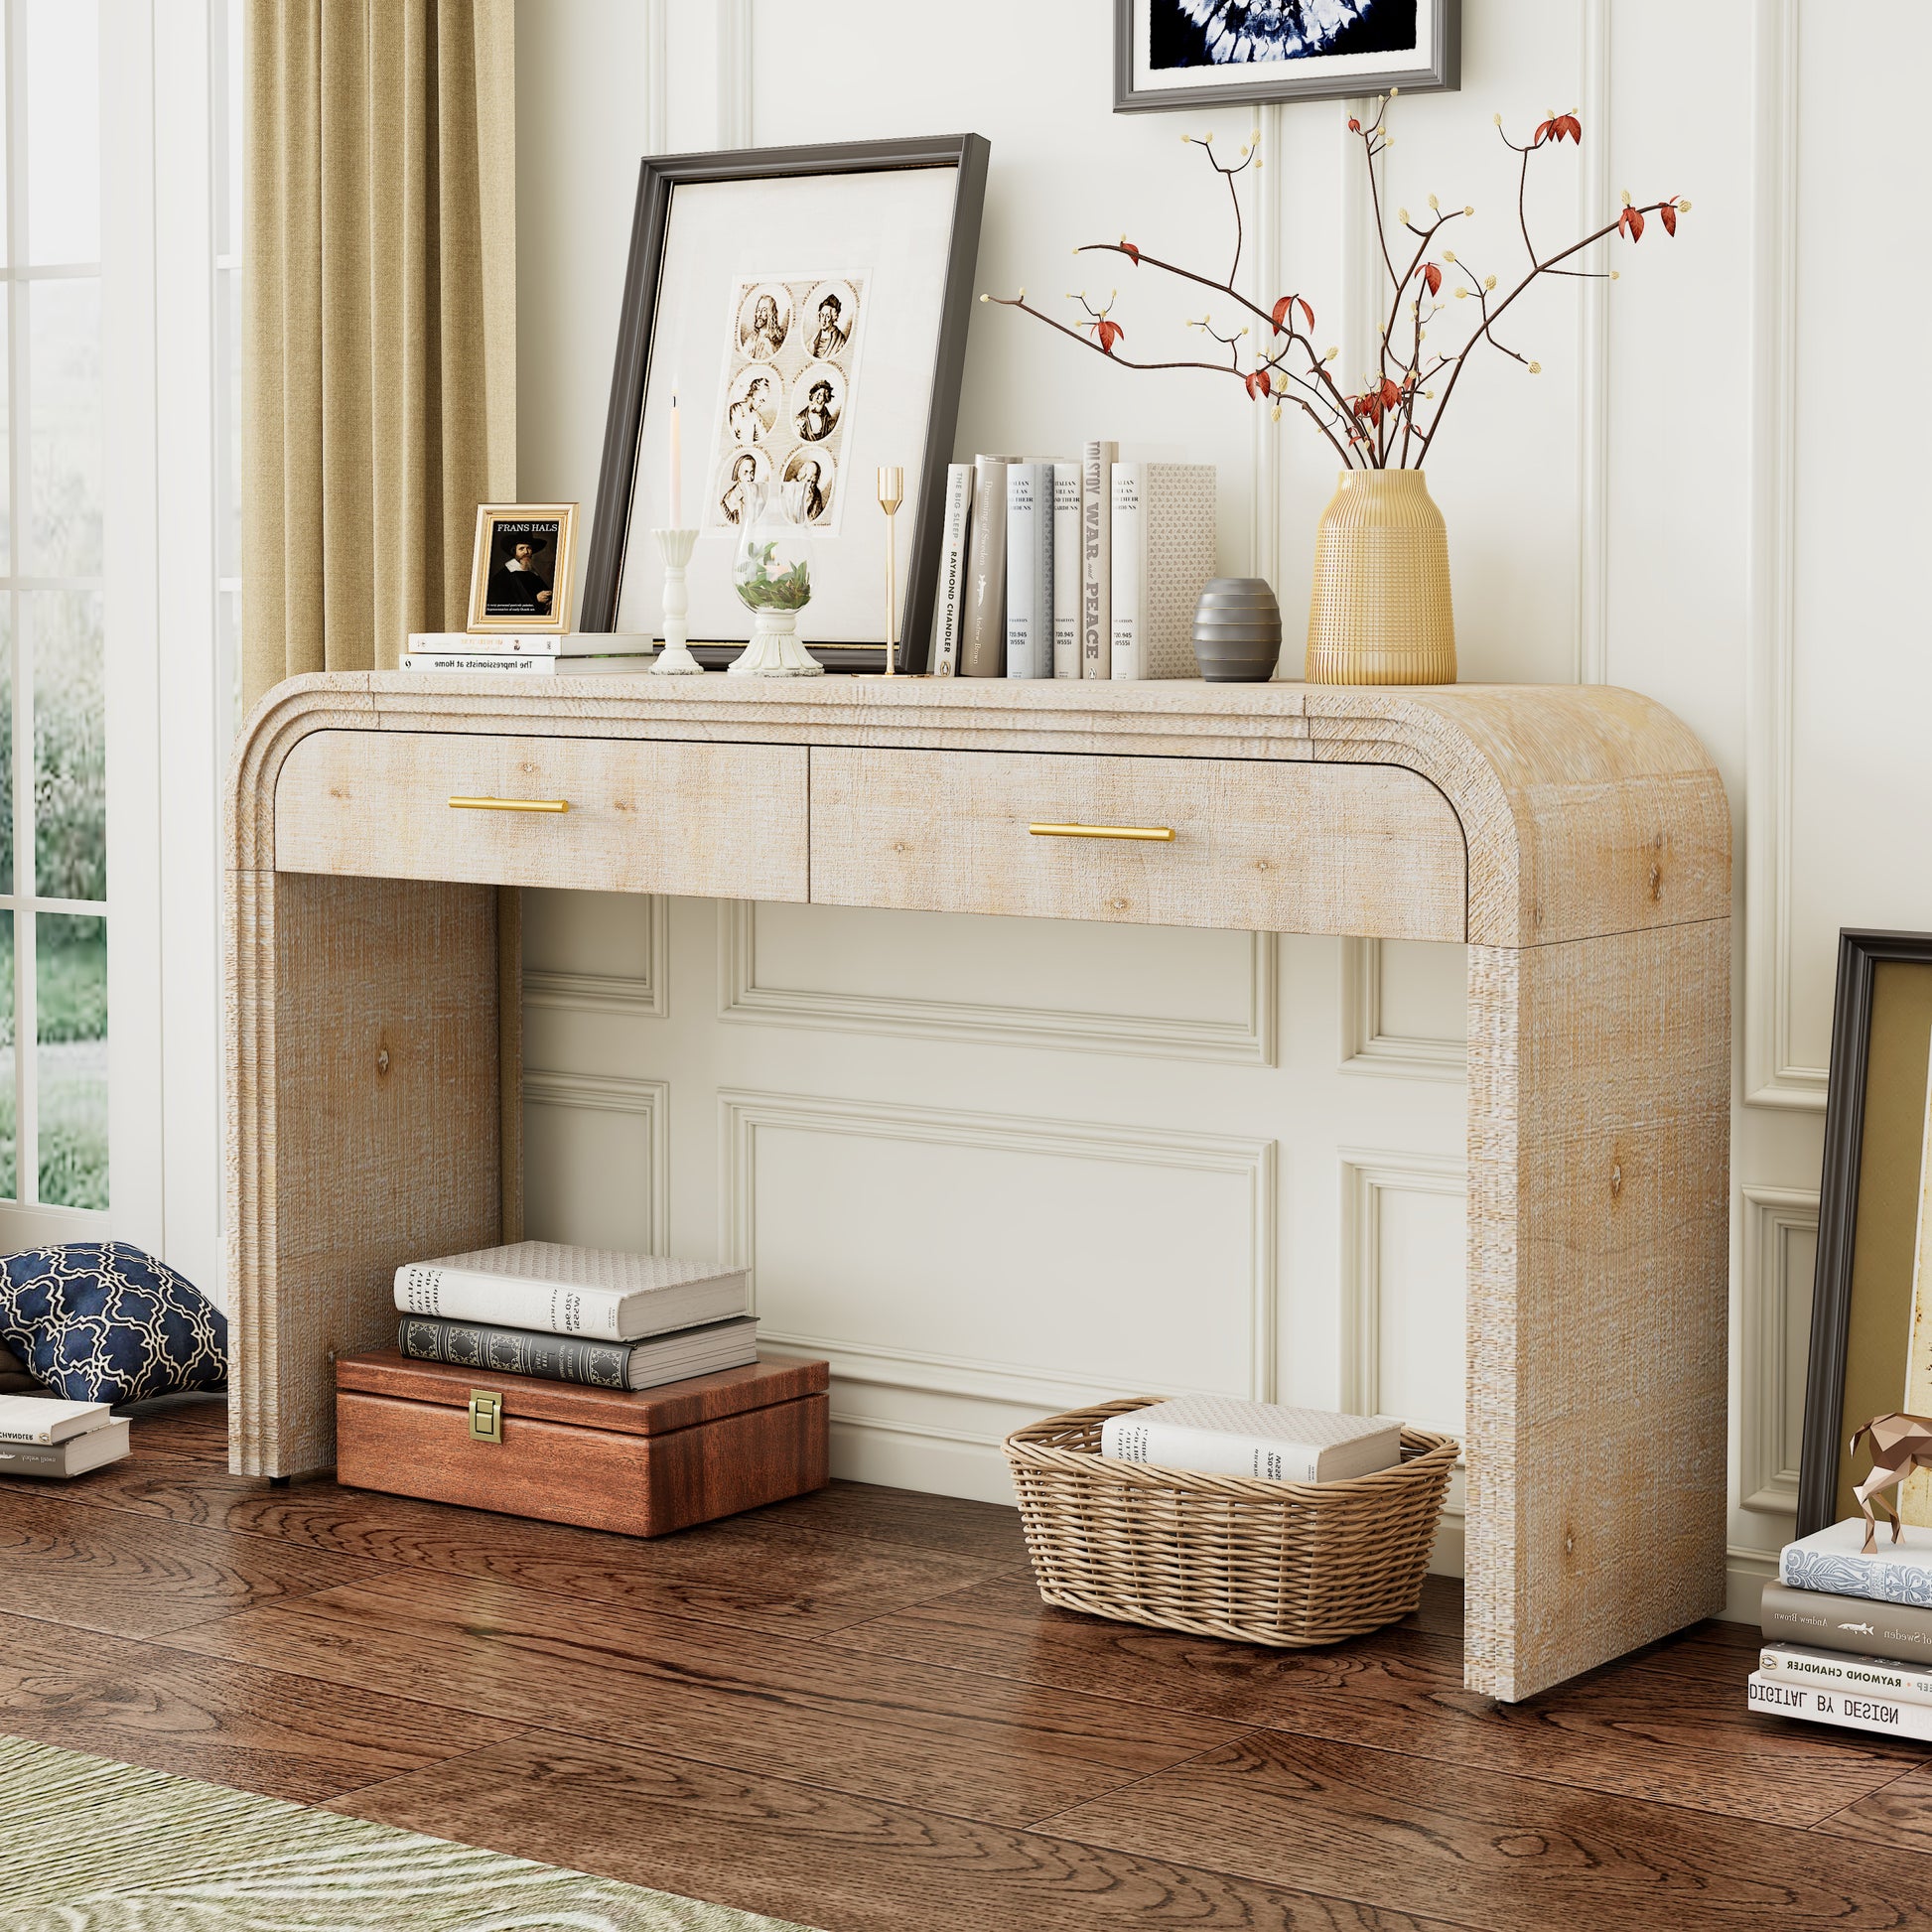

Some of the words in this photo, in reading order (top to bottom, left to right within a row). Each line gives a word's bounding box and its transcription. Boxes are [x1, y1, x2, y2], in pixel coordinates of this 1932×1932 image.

[1086, 441, 1101, 494] TOLSTOY
[1086, 502, 1099, 560] WAR
[948, 551, 958, 600] RAYMOND
[944, 604, 954, 653] CHANDLER
[1086, 582, 1099, 659] PEACE
